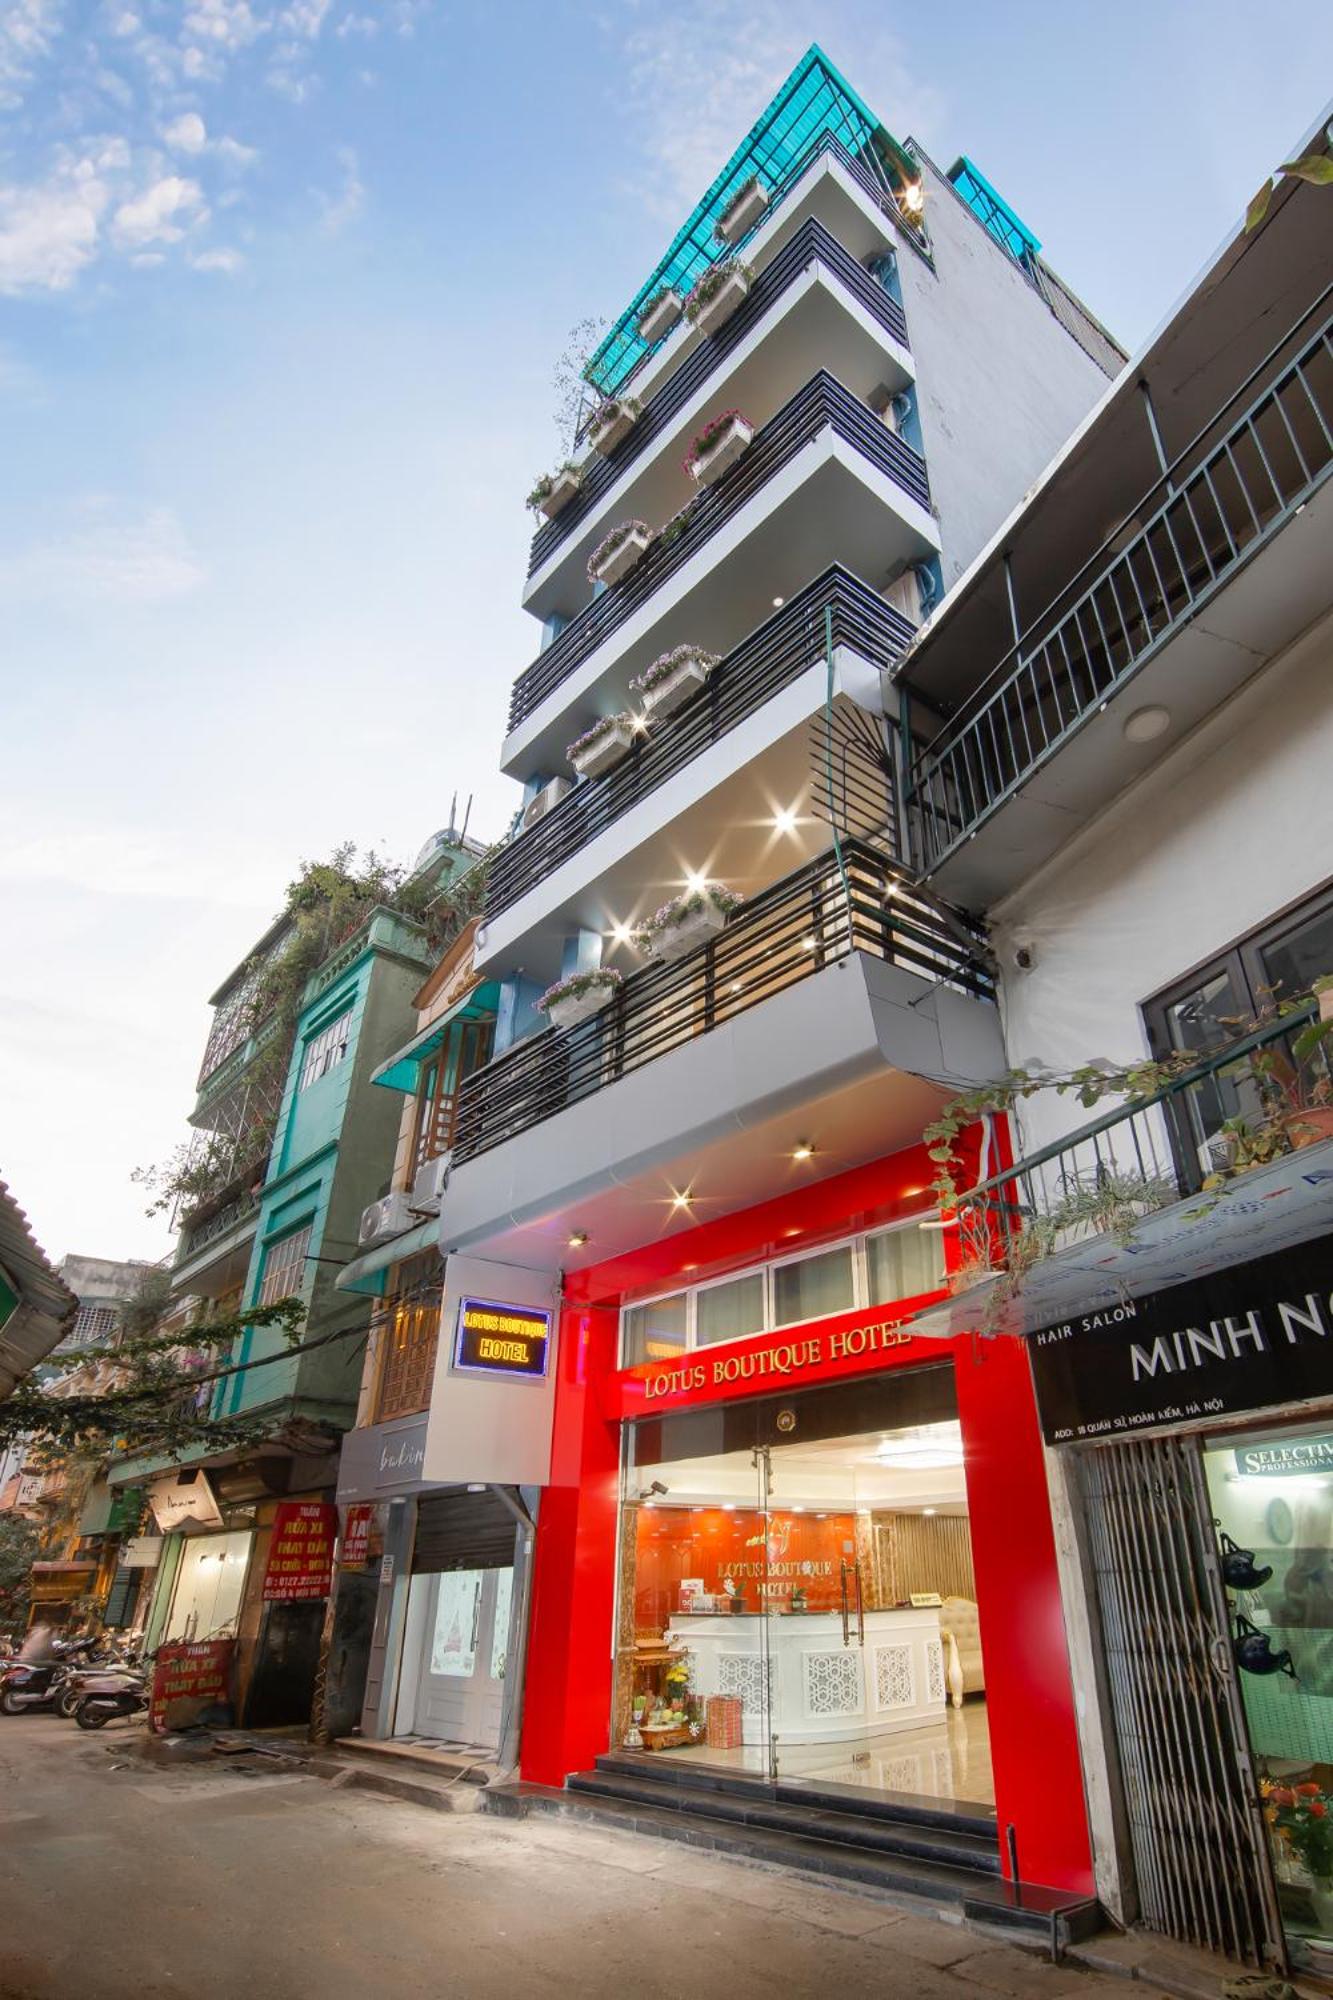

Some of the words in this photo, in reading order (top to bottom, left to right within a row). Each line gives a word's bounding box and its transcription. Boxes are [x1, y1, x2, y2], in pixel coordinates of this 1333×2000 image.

[463, 1312, 498, 1331] LOTUS
[499, 1317, 548, 1338] BOUTIQUE
[1037, 1327, 1073, 1346] HAIR
[1082, 1301, 1137, 1332] SALON
[1130, 1310, 1265, 1381] MINH
[1278, 1293, 1333, 1343] N
[480, 1338, 529, 1363] HOTEL
[644, 1364, 706, 1399] LOTUS
[712, 1338, 821, 1384] BOUTIQUE
[830, 1319, 911, 1359] HOTEL
[717, 1562, 764, 1578] LOTUS
